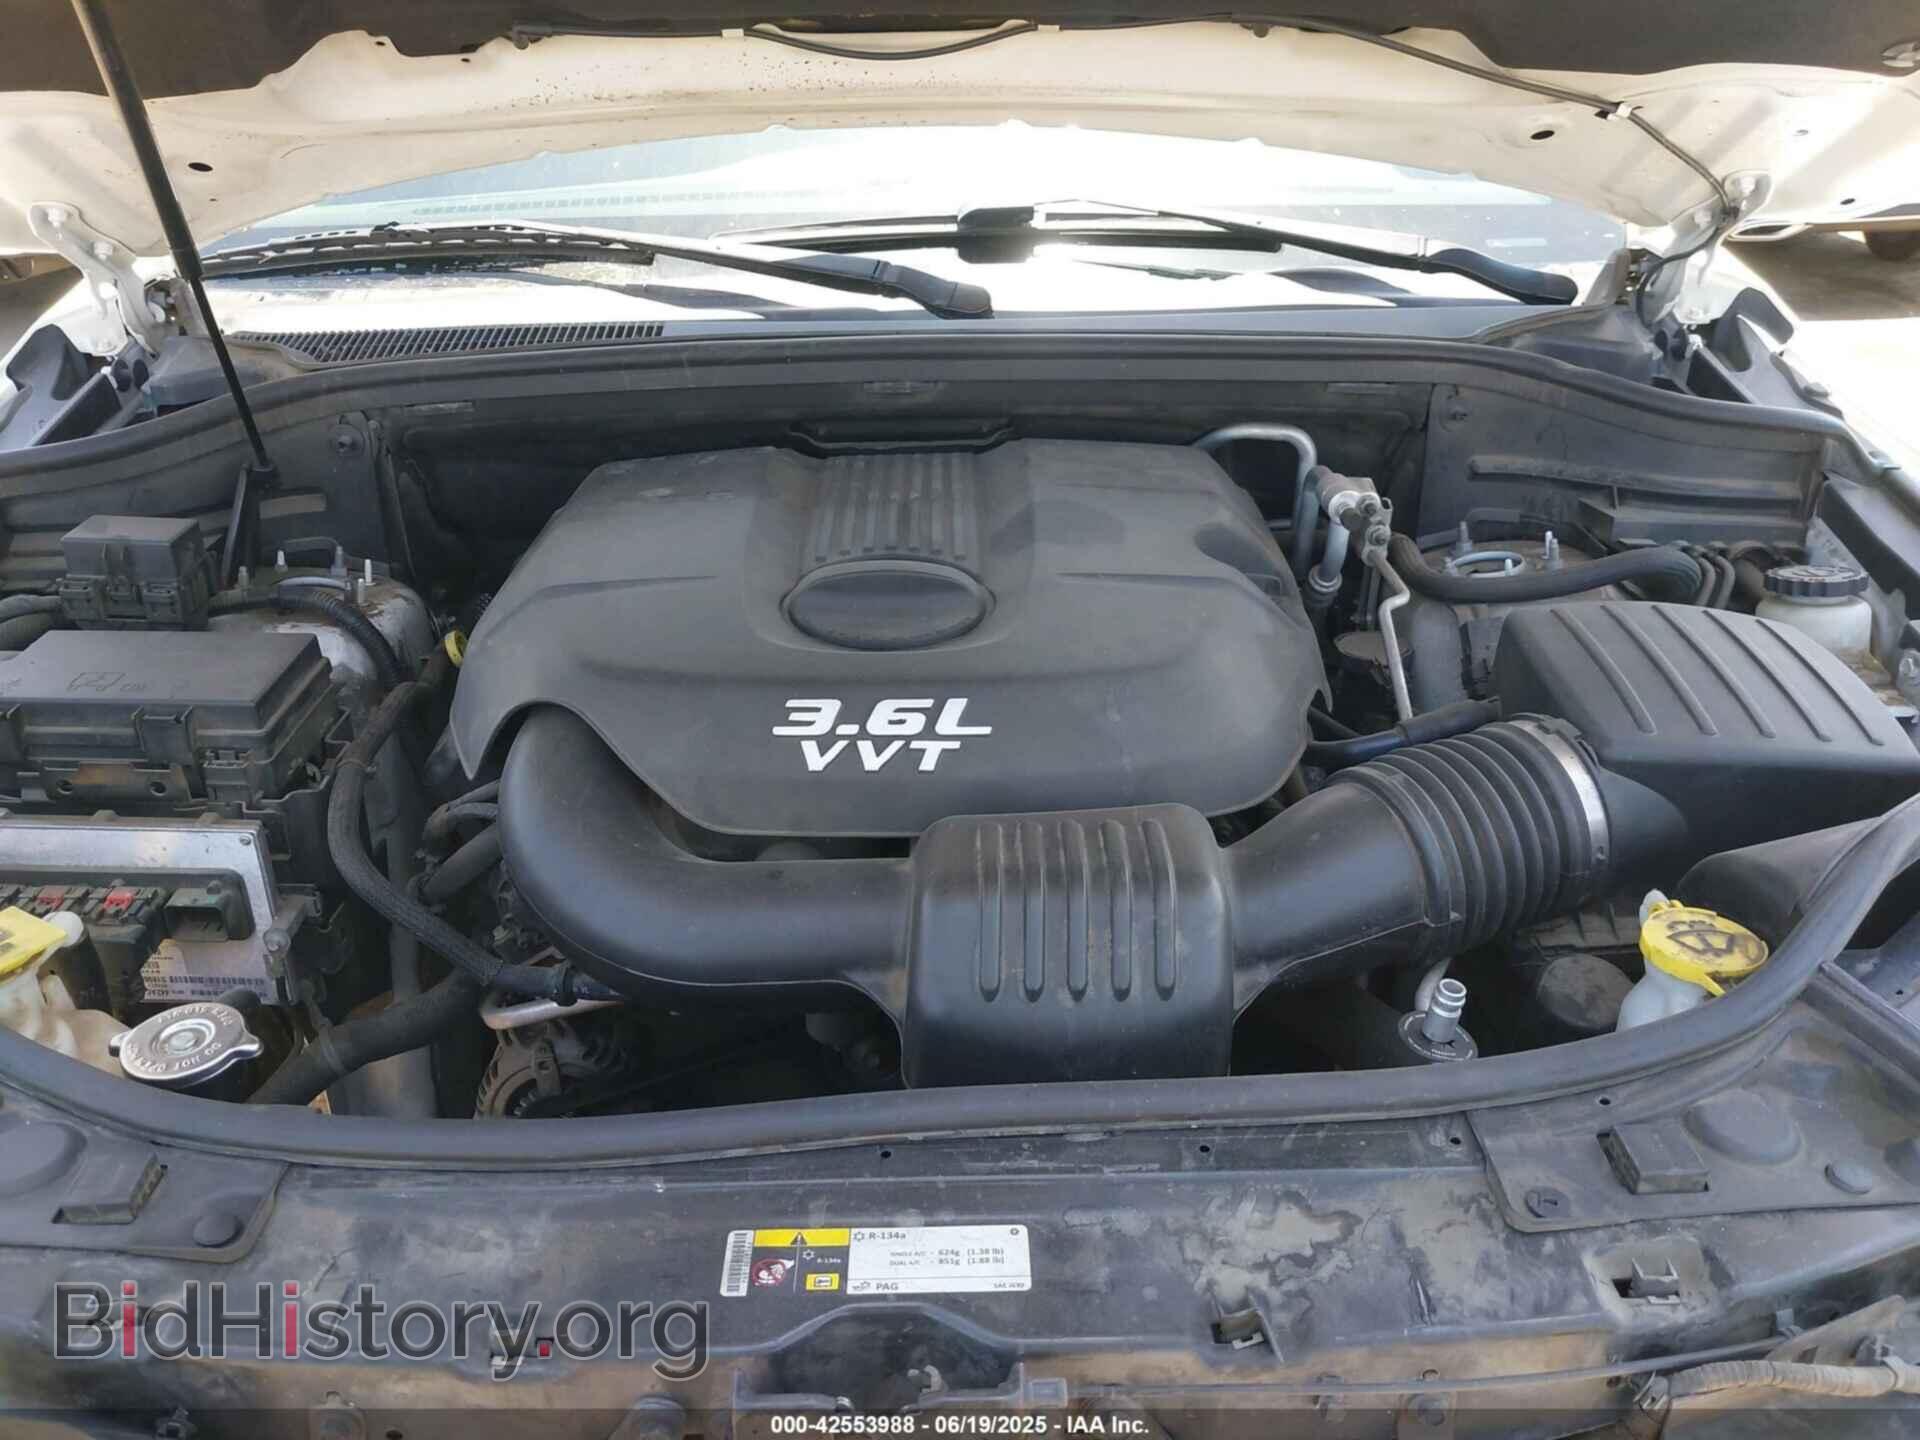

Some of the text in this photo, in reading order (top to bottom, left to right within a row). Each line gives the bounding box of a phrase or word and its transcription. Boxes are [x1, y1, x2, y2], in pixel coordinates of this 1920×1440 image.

[772, 698, 993, 736] 3.6L
[800, 740, 961, 772] VVT
[868, 1231, 906, 1240] R-134a
[938, 1248, 960, 1257] 624g
[938, 1257, 960, 1266] 851g
[876, 1282, 899, 1291] PAG
